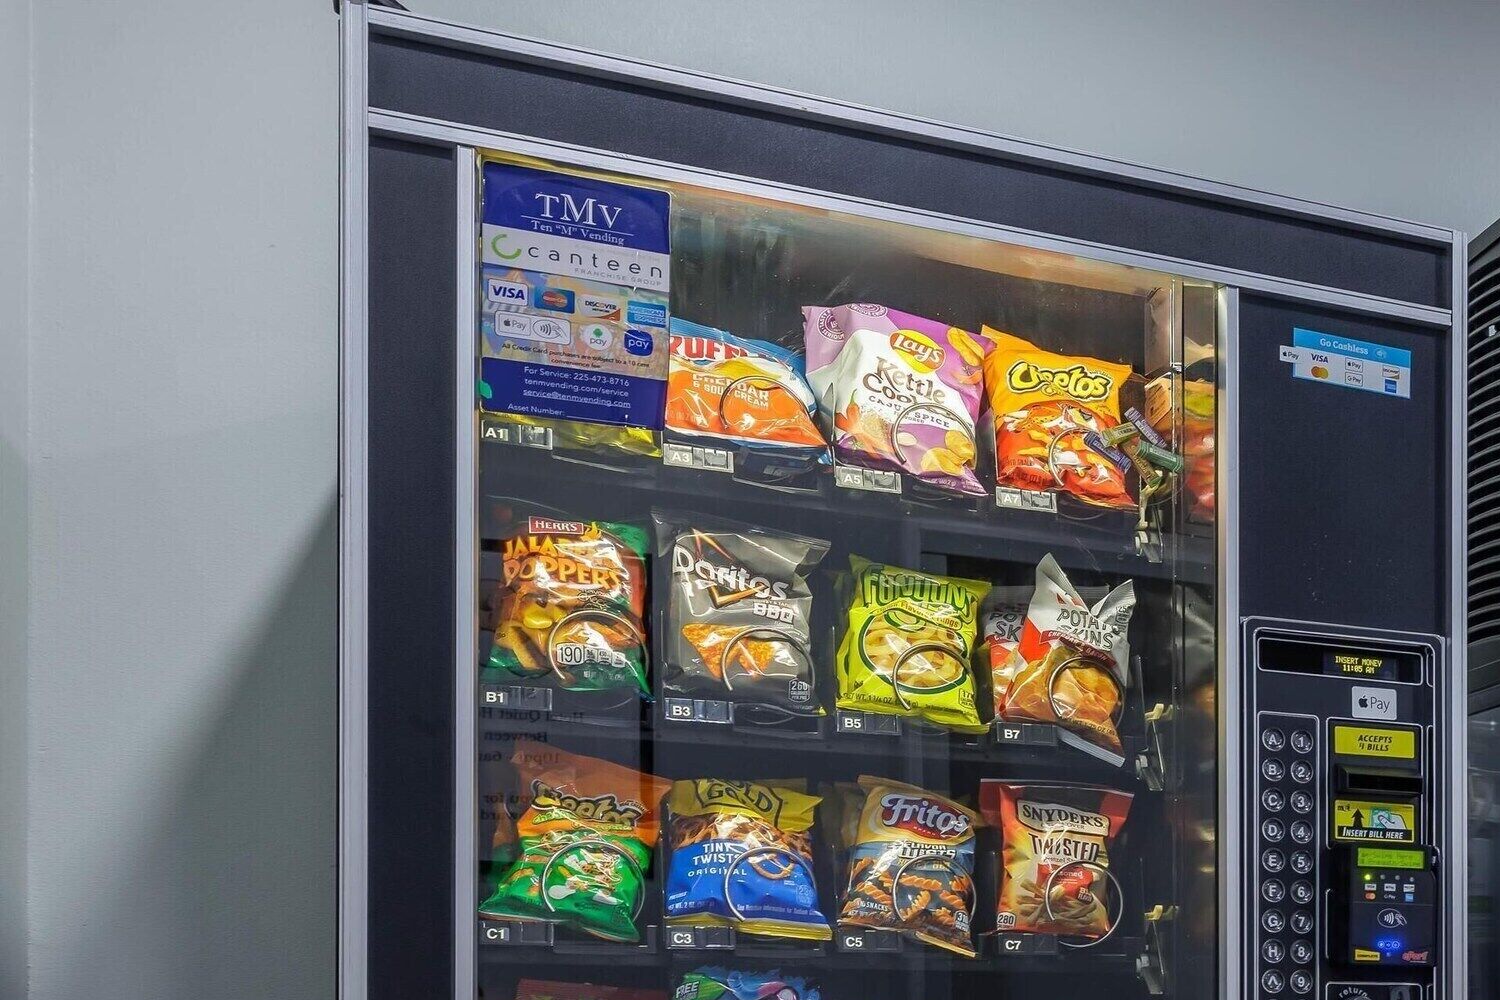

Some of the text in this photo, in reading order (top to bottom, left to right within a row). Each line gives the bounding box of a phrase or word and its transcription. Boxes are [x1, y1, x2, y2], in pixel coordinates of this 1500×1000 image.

[535, 192, 622, 229] TMV
[531, 219, 552, 232] Ten
[581, 229, 624, 245] Vending
[528, 246, 662, 278] canteen
[574, 267, 662, 287] FRANCHISE GROUP
[492, 286, 525, 301] VISA
[585, 300, 617, 311] DISCOVER
[512, 319, 527, 332] Pay
[588, 335, 608, 348] pay
[628, 337, 650, 350] pay
[1320, 338, 1369, 355] Go Cashless
[1288, 351, 1299, 360] Pay
[1310, 353, 1329, 364] VISA
[1351, 362, 1361, 370] Pay
[524, 366, 630, 387] For Service: 225-473-8716
[876, 357, 946, 404] Kettle
[1008, 363, 1109, 398] Cheetos
[524, 378, 629, 397] tenmvending.com/service
[523, 388, 631, 408] service@tenmvending.com
[734, 390, 769, 408] CREAM
[508, 403, 565, 416] Asset Number:
[915, 411, 950, 428] SPICE
[671, 452, 690, 463] A3
[843, 473, 861, 485] A5
[1003, 494, 1019, 504] A7
[534, 520, 578, 532] HERR'S
[503, 555, 621, 590] POPPERS
[673, 544, 790, 600] Doritos
[753, 601, 794, 624] BBQ
[559, 646, 583, 663] 190
[1334, 655, 1383, 668] INSERT MONEY
[1342, 664, 1363, 673] 11:05
[791, 680, 808, 690] 260
[485, 691, 504, 702] B1
[672, 705, 691, 716] B3
[1370, 696, 1390, 713] Pay
[844, 718, 861, 728] B5
[1004, 729, 1020, 739] B7
[1357, 734, 1393, 744] ACCEPTS
[1367, 743, 1390, 752] BILLS
[881, 794, 969, 832] Fritos
[1022, 804, 1104, 828] SNYDER'S
[1342, 827, 1404, 840] INSERT BILL HERE
[702, 843, 731, 854] TINY
[1028, 832, 1100, 862] TWISTED
[688, 868, 747, 877] ORIGINAL
[866, 902, 888, 911] SNACKS
[998, 914, 1014, 925] 280
[486, 928, 505, 939] C1
[673, 934, 692, 944] C3
[846, 937, 863, 947] C5
[1005, 940, 1021, 950] C7
[676, 981, 699, 998] FREE
[1338, 987, 1369, 999] return
